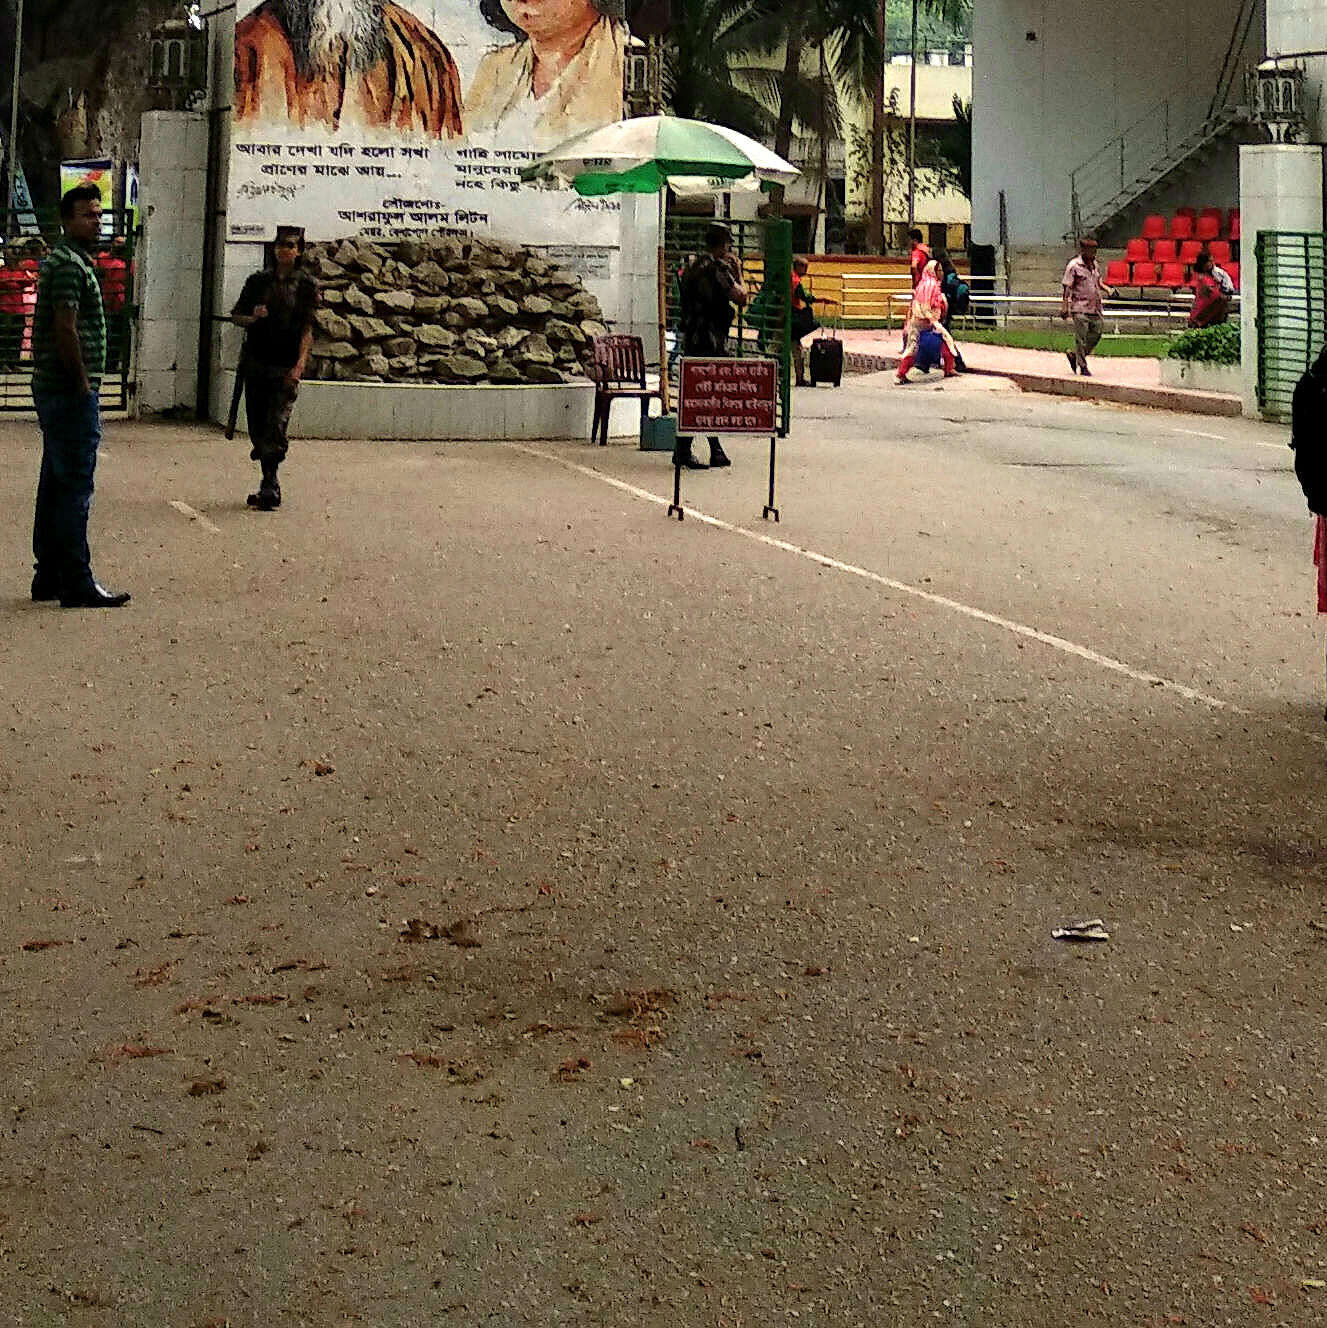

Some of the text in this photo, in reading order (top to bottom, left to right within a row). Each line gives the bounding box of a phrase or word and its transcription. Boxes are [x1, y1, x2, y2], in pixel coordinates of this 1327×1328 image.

[235, 143, 282, 157] আবার
[286, 144, 322, 157] দেখা
[409, 211, 451, 225] আলম
[454, 209, 489, 225] লিটন
